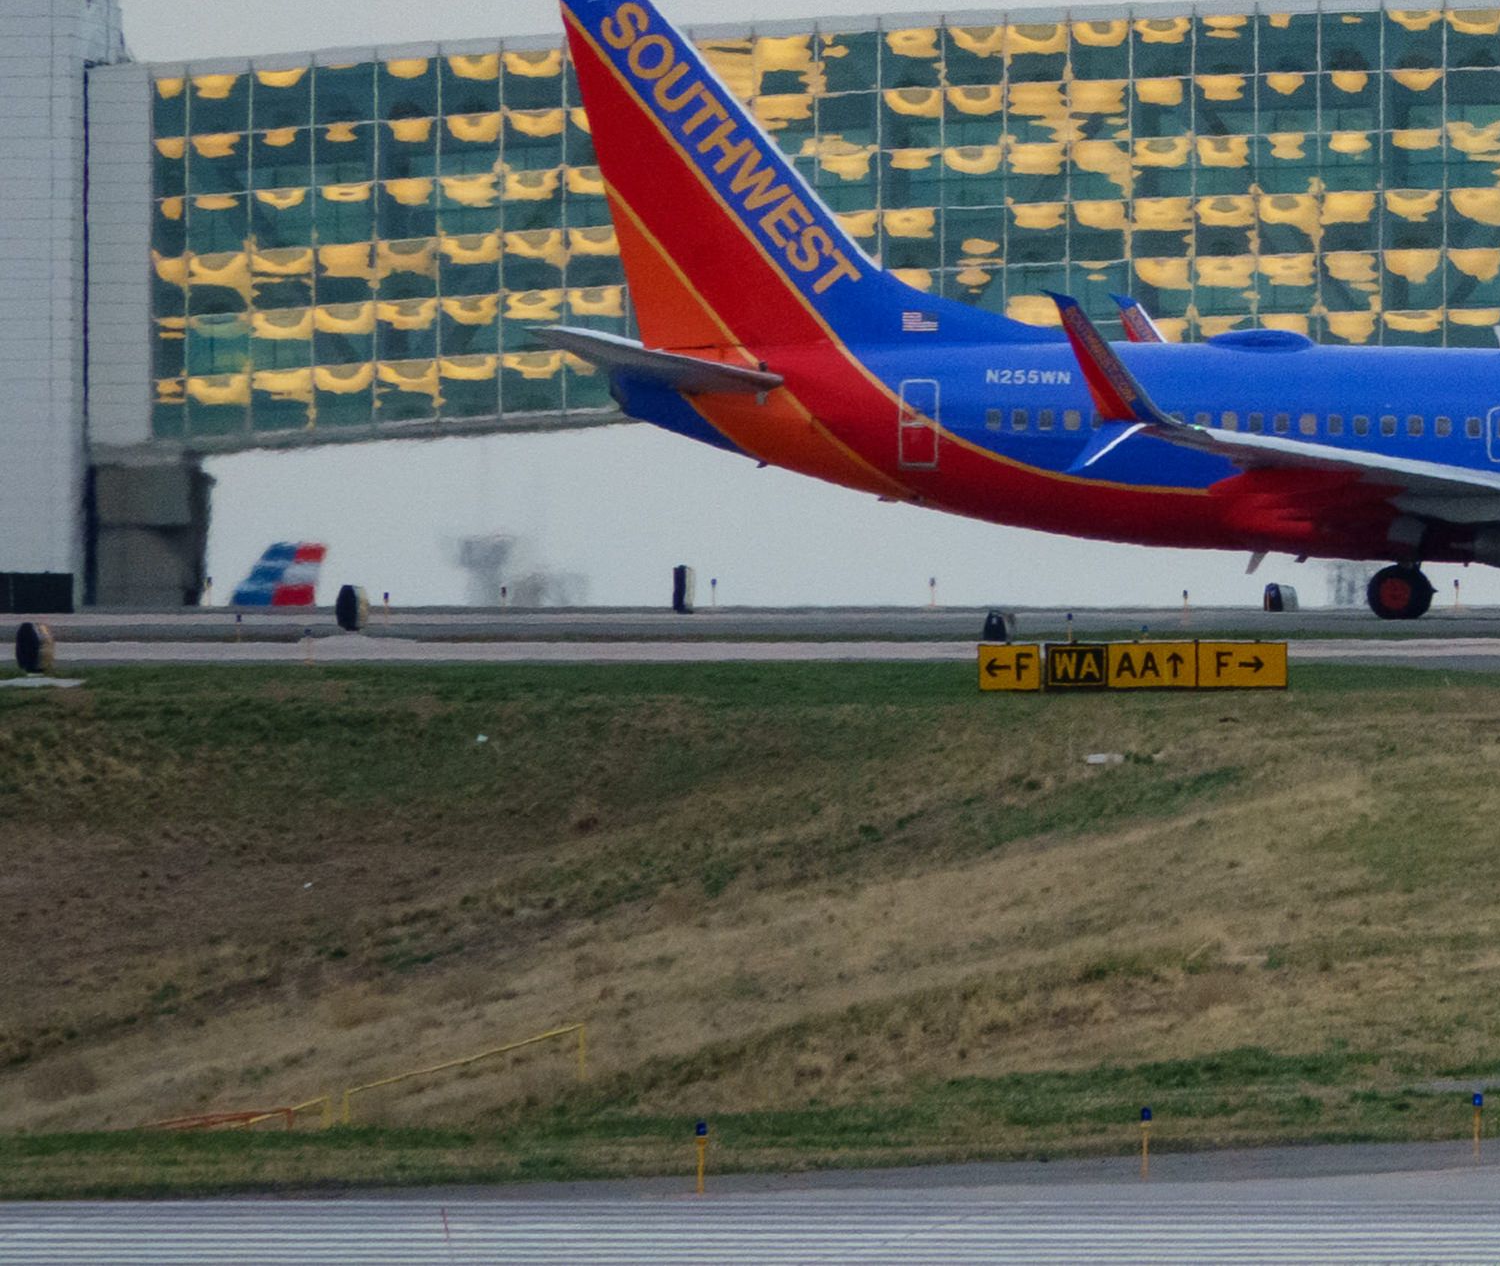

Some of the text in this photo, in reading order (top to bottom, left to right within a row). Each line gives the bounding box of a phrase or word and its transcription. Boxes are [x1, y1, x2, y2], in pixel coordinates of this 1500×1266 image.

[600, 2, 862, 294] SOUTHWEST
[985, 369, 1071, 384] N255WN
[1015, 651, 1233, 681] F WA AA F
